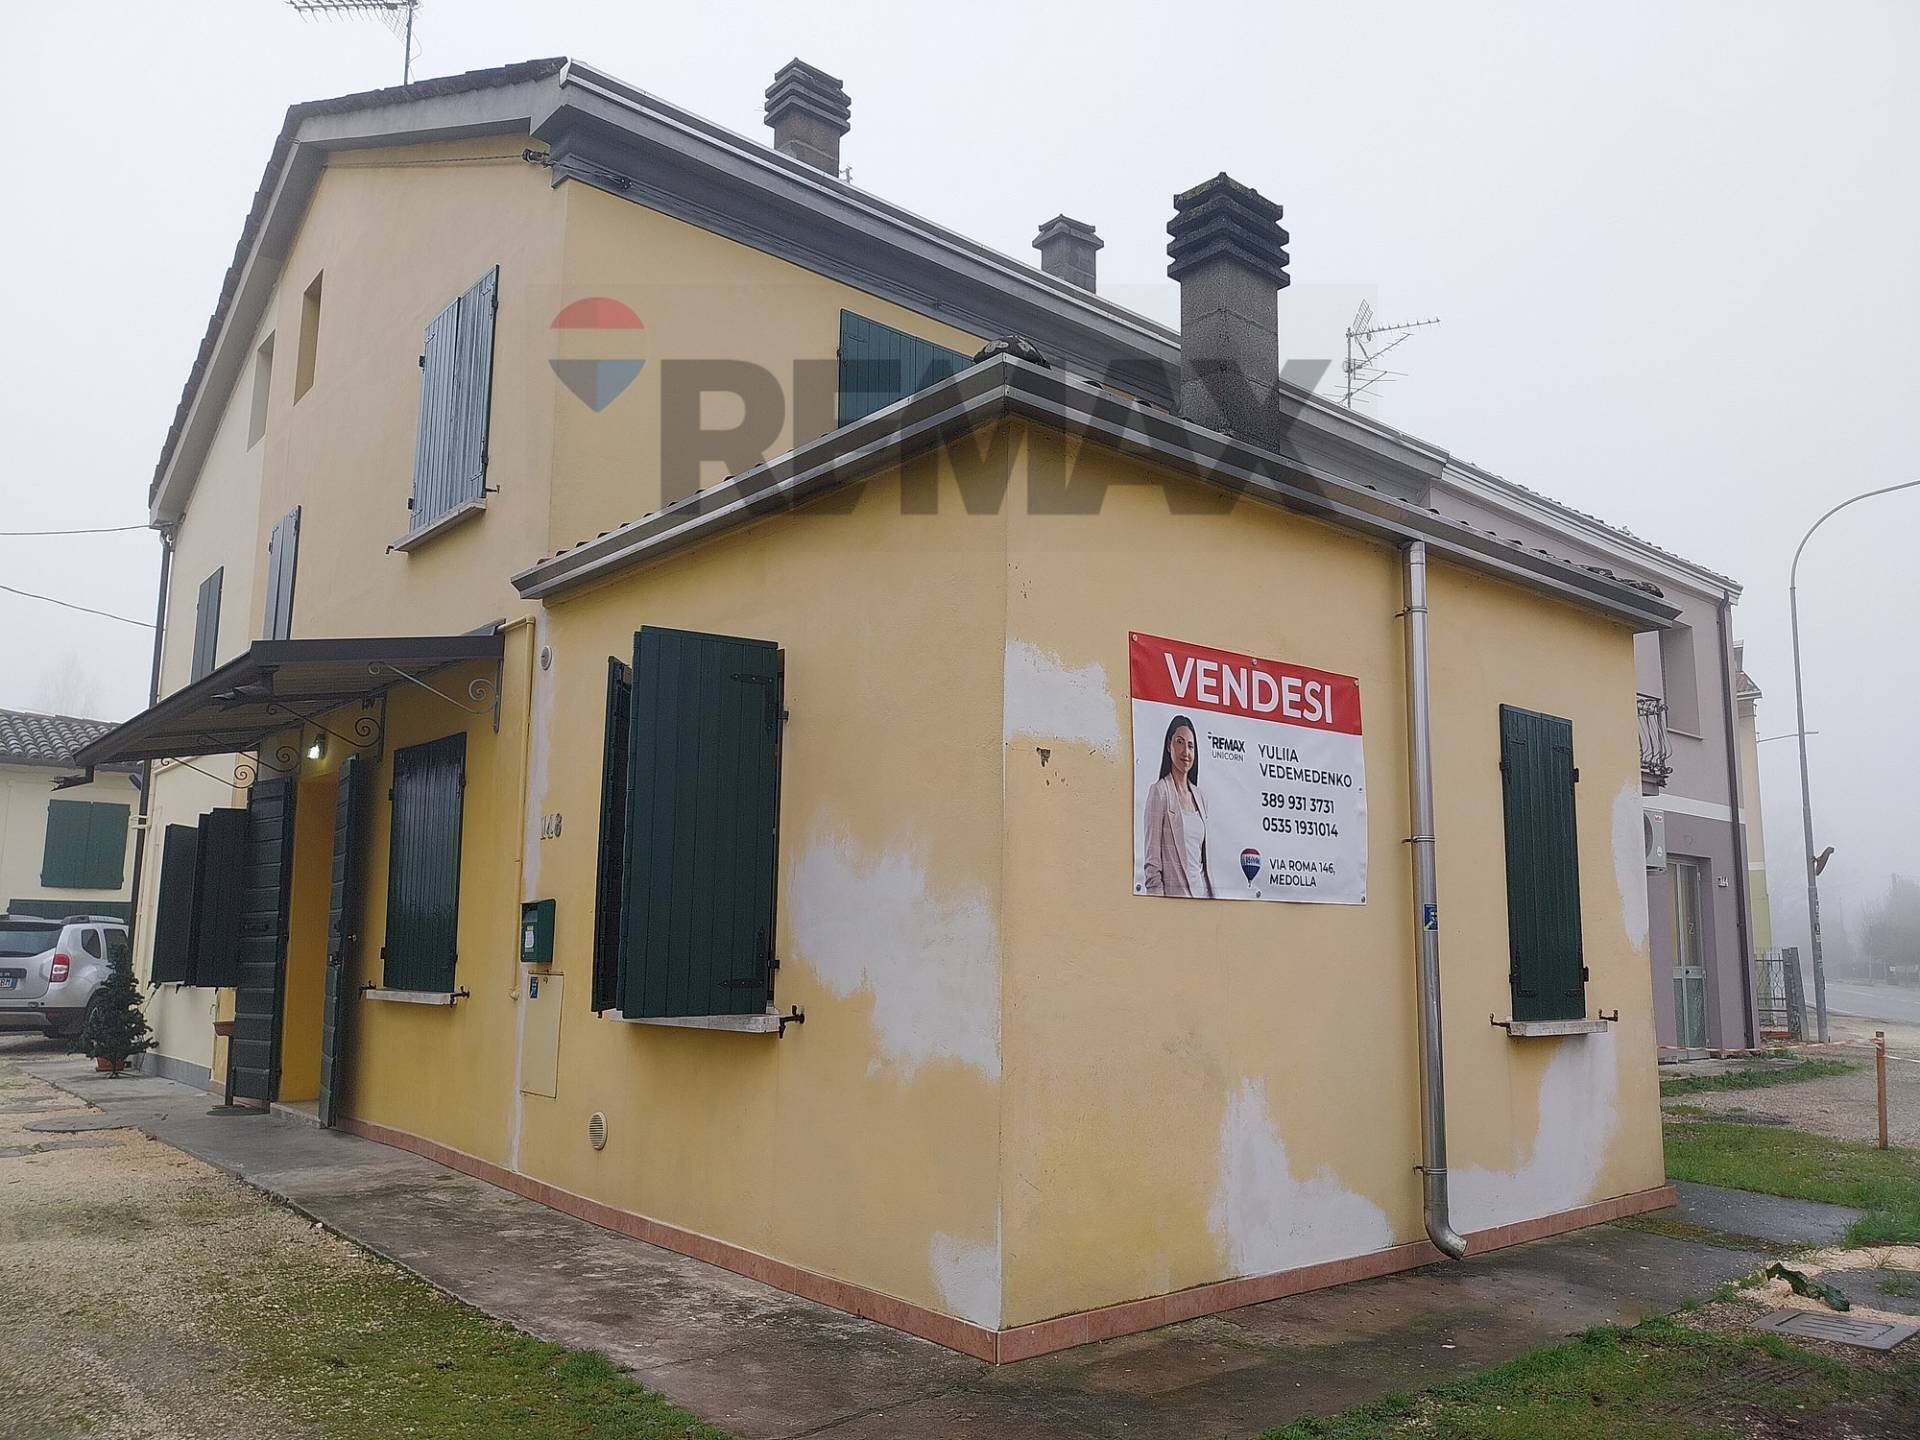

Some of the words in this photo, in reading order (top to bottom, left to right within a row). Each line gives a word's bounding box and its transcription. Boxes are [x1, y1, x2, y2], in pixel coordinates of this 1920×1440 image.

[1164, 652, 1333, 723] VENDESI
[1211, 750, 1244, 762] UNICORN
[1258, 743, 1299, 762] YULIIA
[1259, 762, 1352, 787] VEDEMEDENKO
[1261, 792, 1285, 808] 389
[1288, 795, 1307, 811] 931
[1309, 798, 1335, 814] 3731
[1262, 816, 1292, 833] 0535
[1294, 819, 1339, 837] 1931014
[1269, 858, 1287, 870] VIA
[1288, 859, 1318, 872] ROMA
[1269, 873, 1317, 887] MEDOLLA
